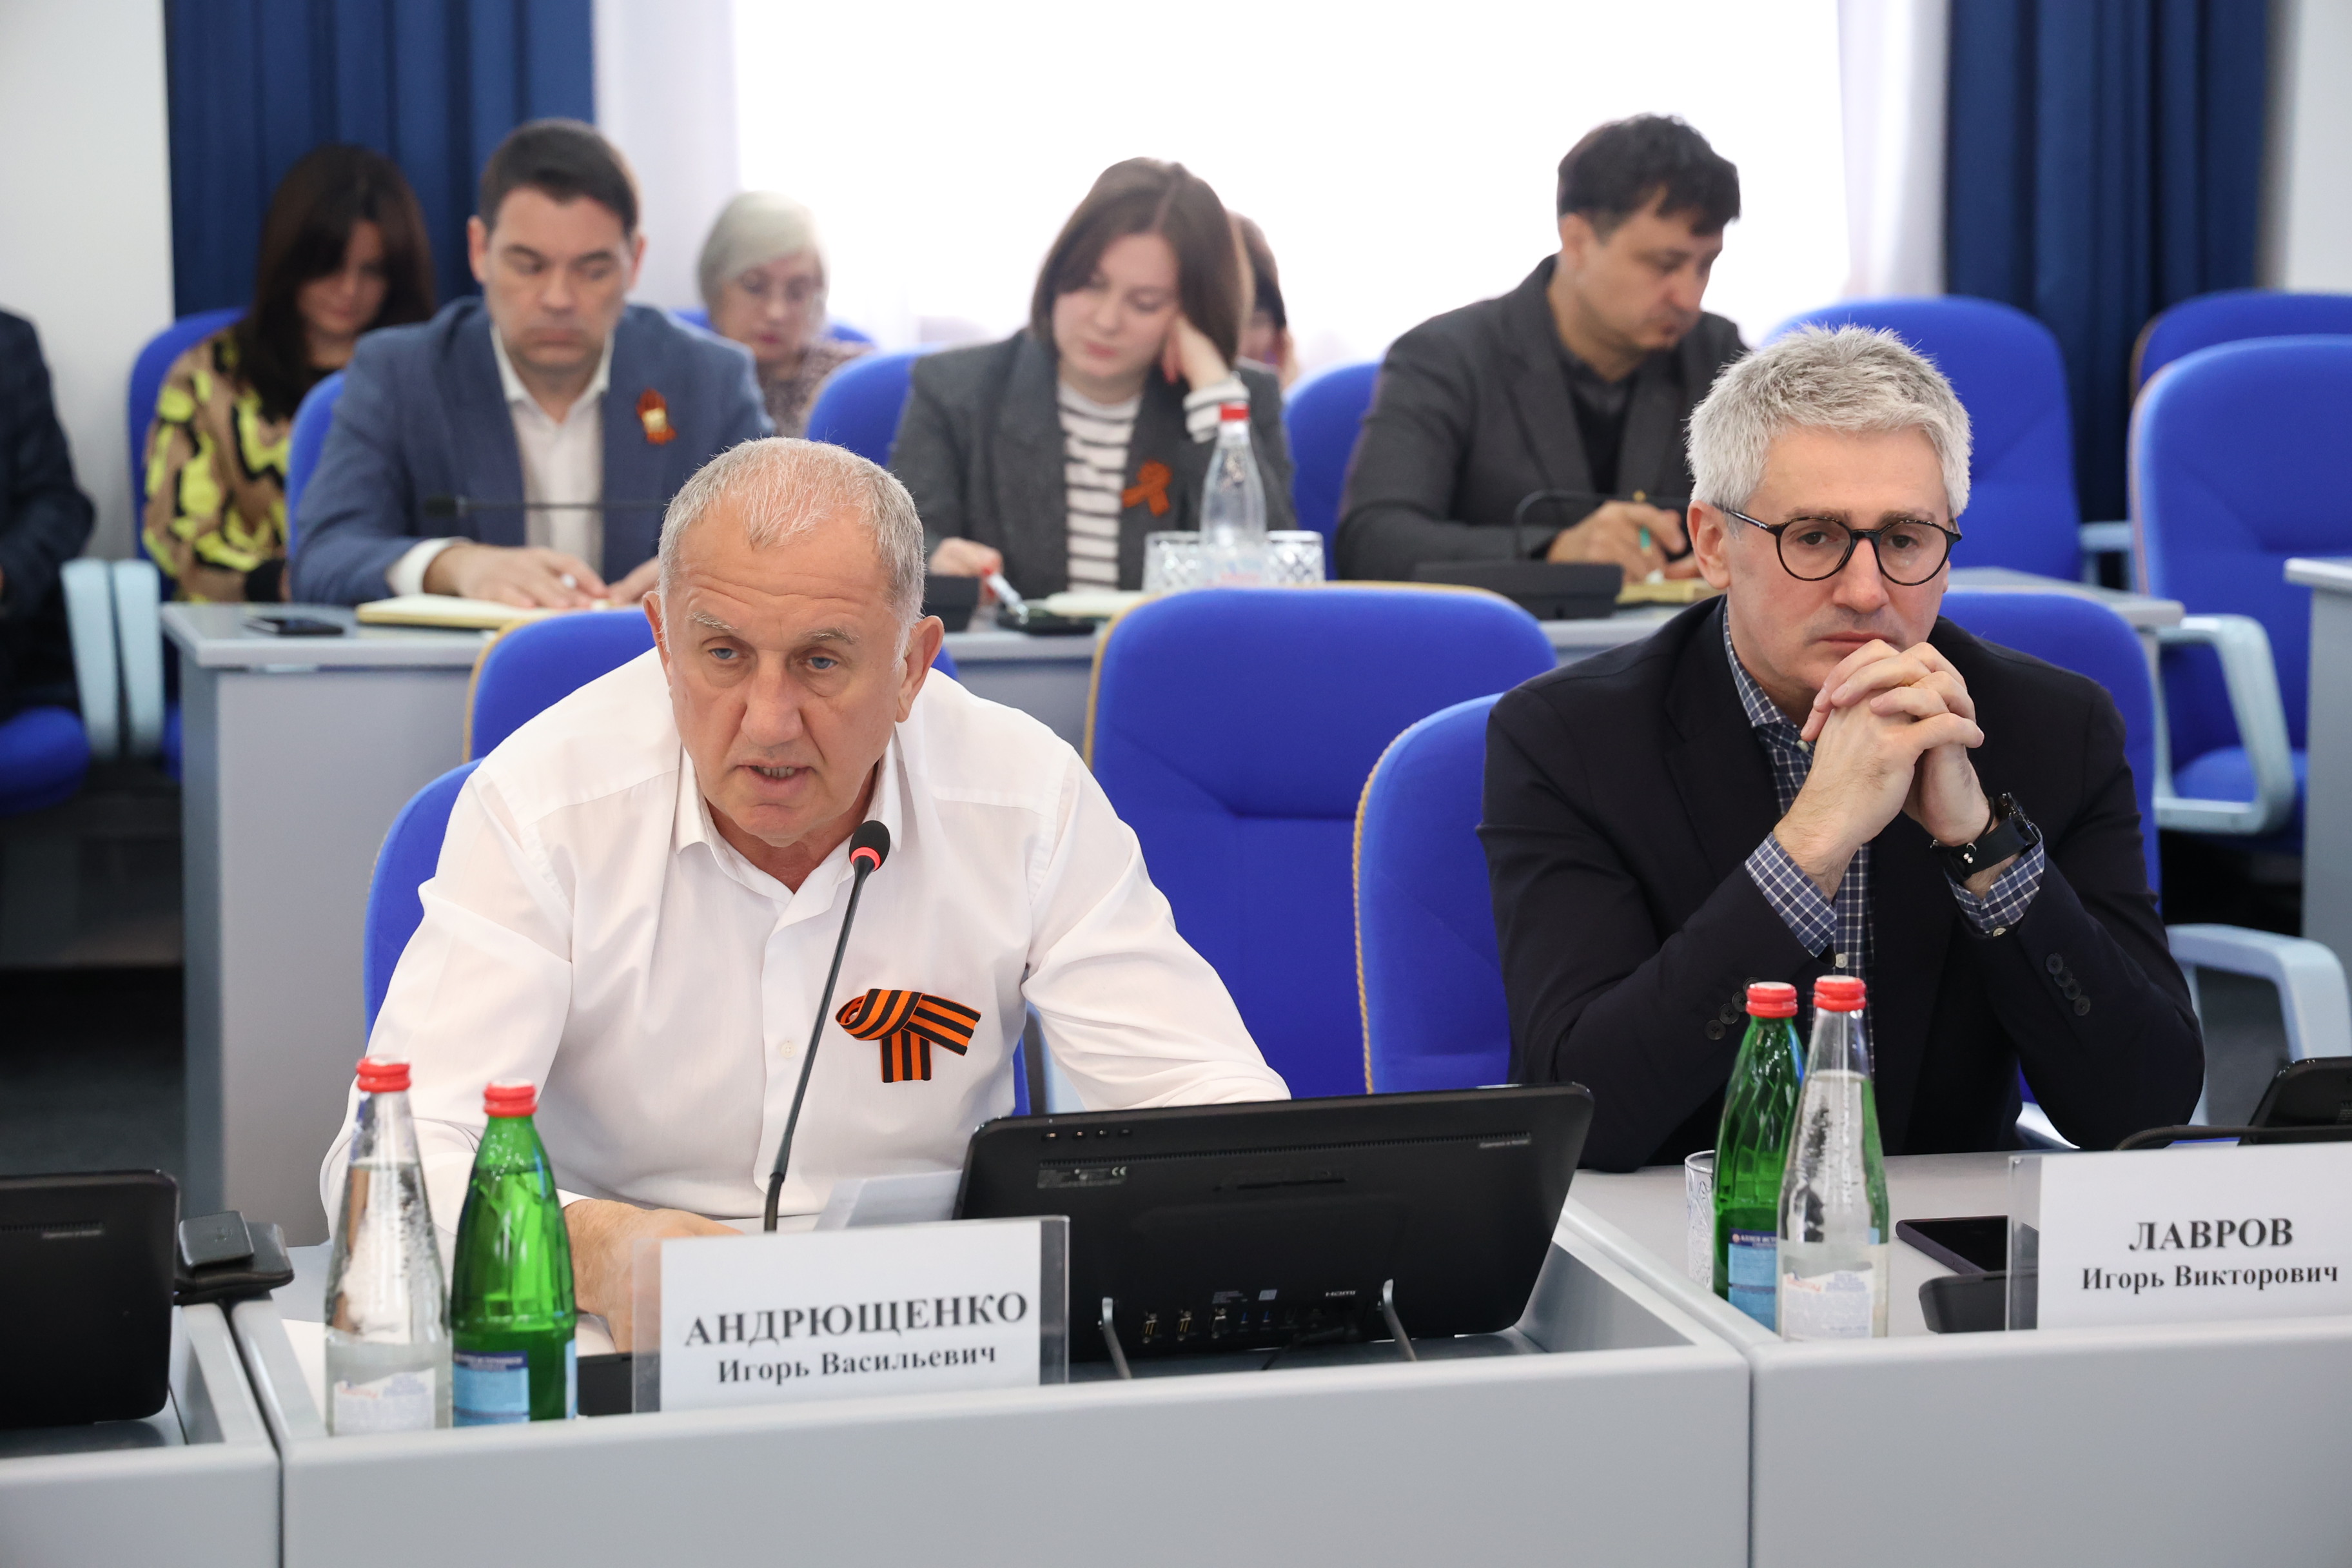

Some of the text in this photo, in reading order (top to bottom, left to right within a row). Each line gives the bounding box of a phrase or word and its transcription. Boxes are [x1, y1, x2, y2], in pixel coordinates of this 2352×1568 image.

[2128, 1217, 2293, 1251] ЛАВРОВ
[2082, 1265, 2338, 1295] Игорь Викторович
[685, 1291, 1028, 1348] АНДРЮЩЕНКО
[718, 1348, 996, 1386] Игорь Васильевич
